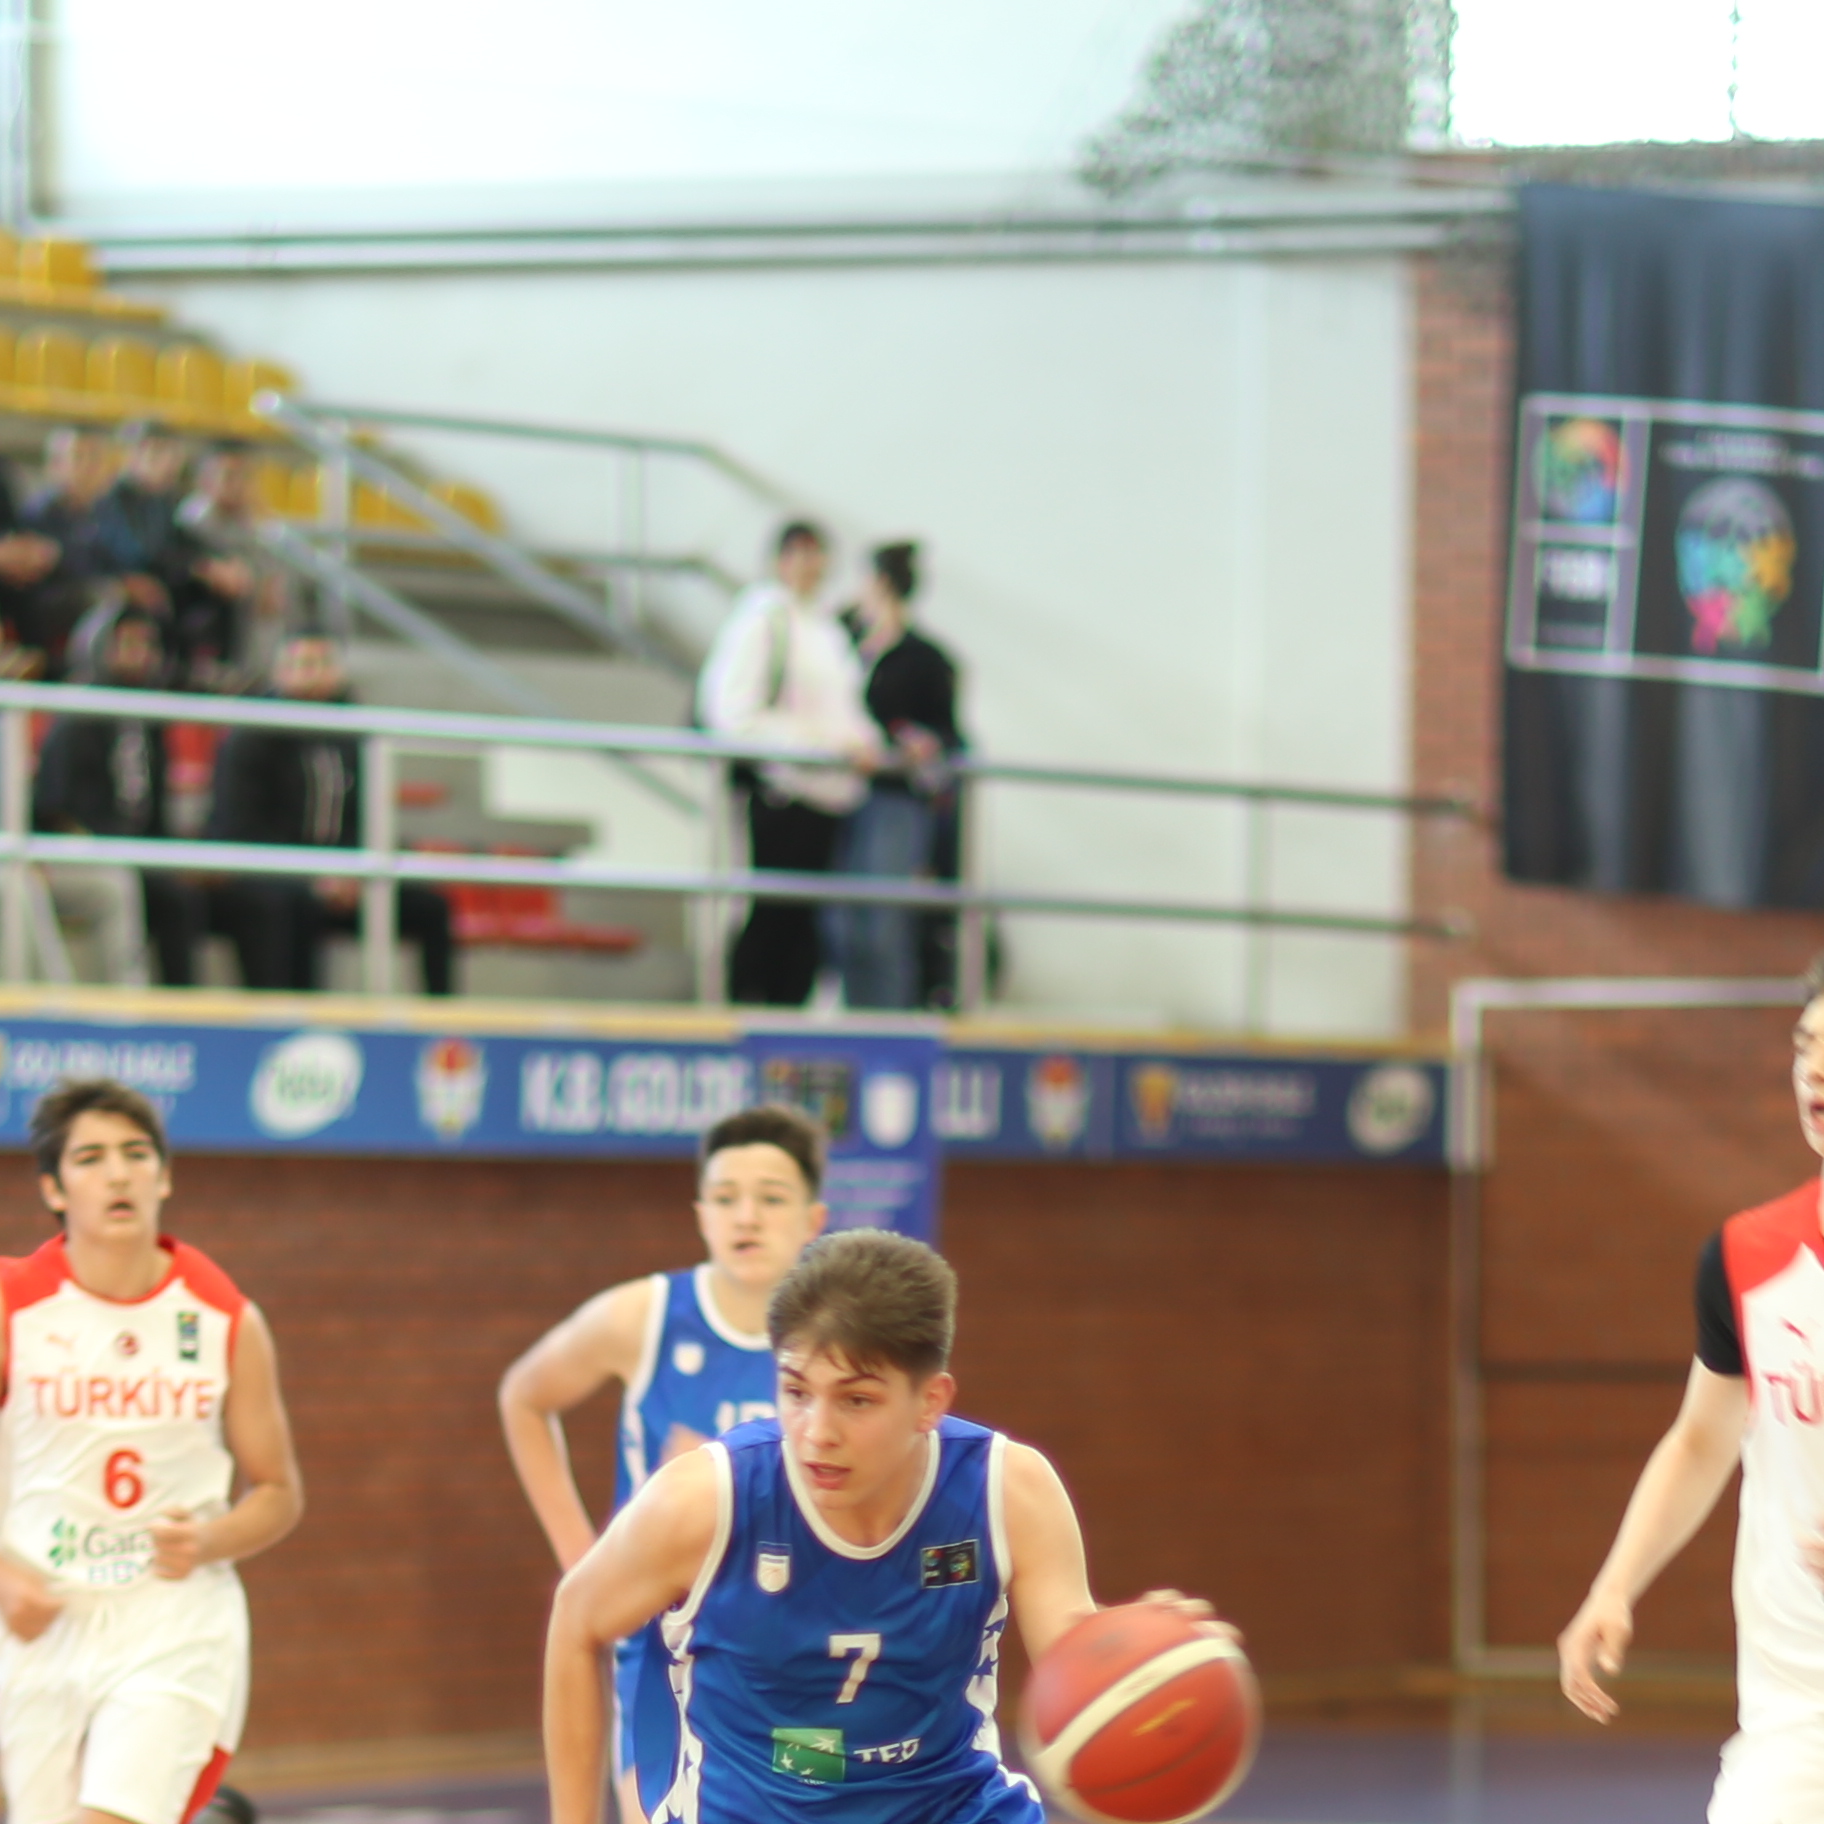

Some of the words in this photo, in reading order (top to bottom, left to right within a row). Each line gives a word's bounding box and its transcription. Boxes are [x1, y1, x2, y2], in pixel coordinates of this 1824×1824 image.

[27, 1366, 218, 1421] TÜRKİYE
[104, 1448, 146, 1510] 6
[828, 1633, 882, 1704] 7
